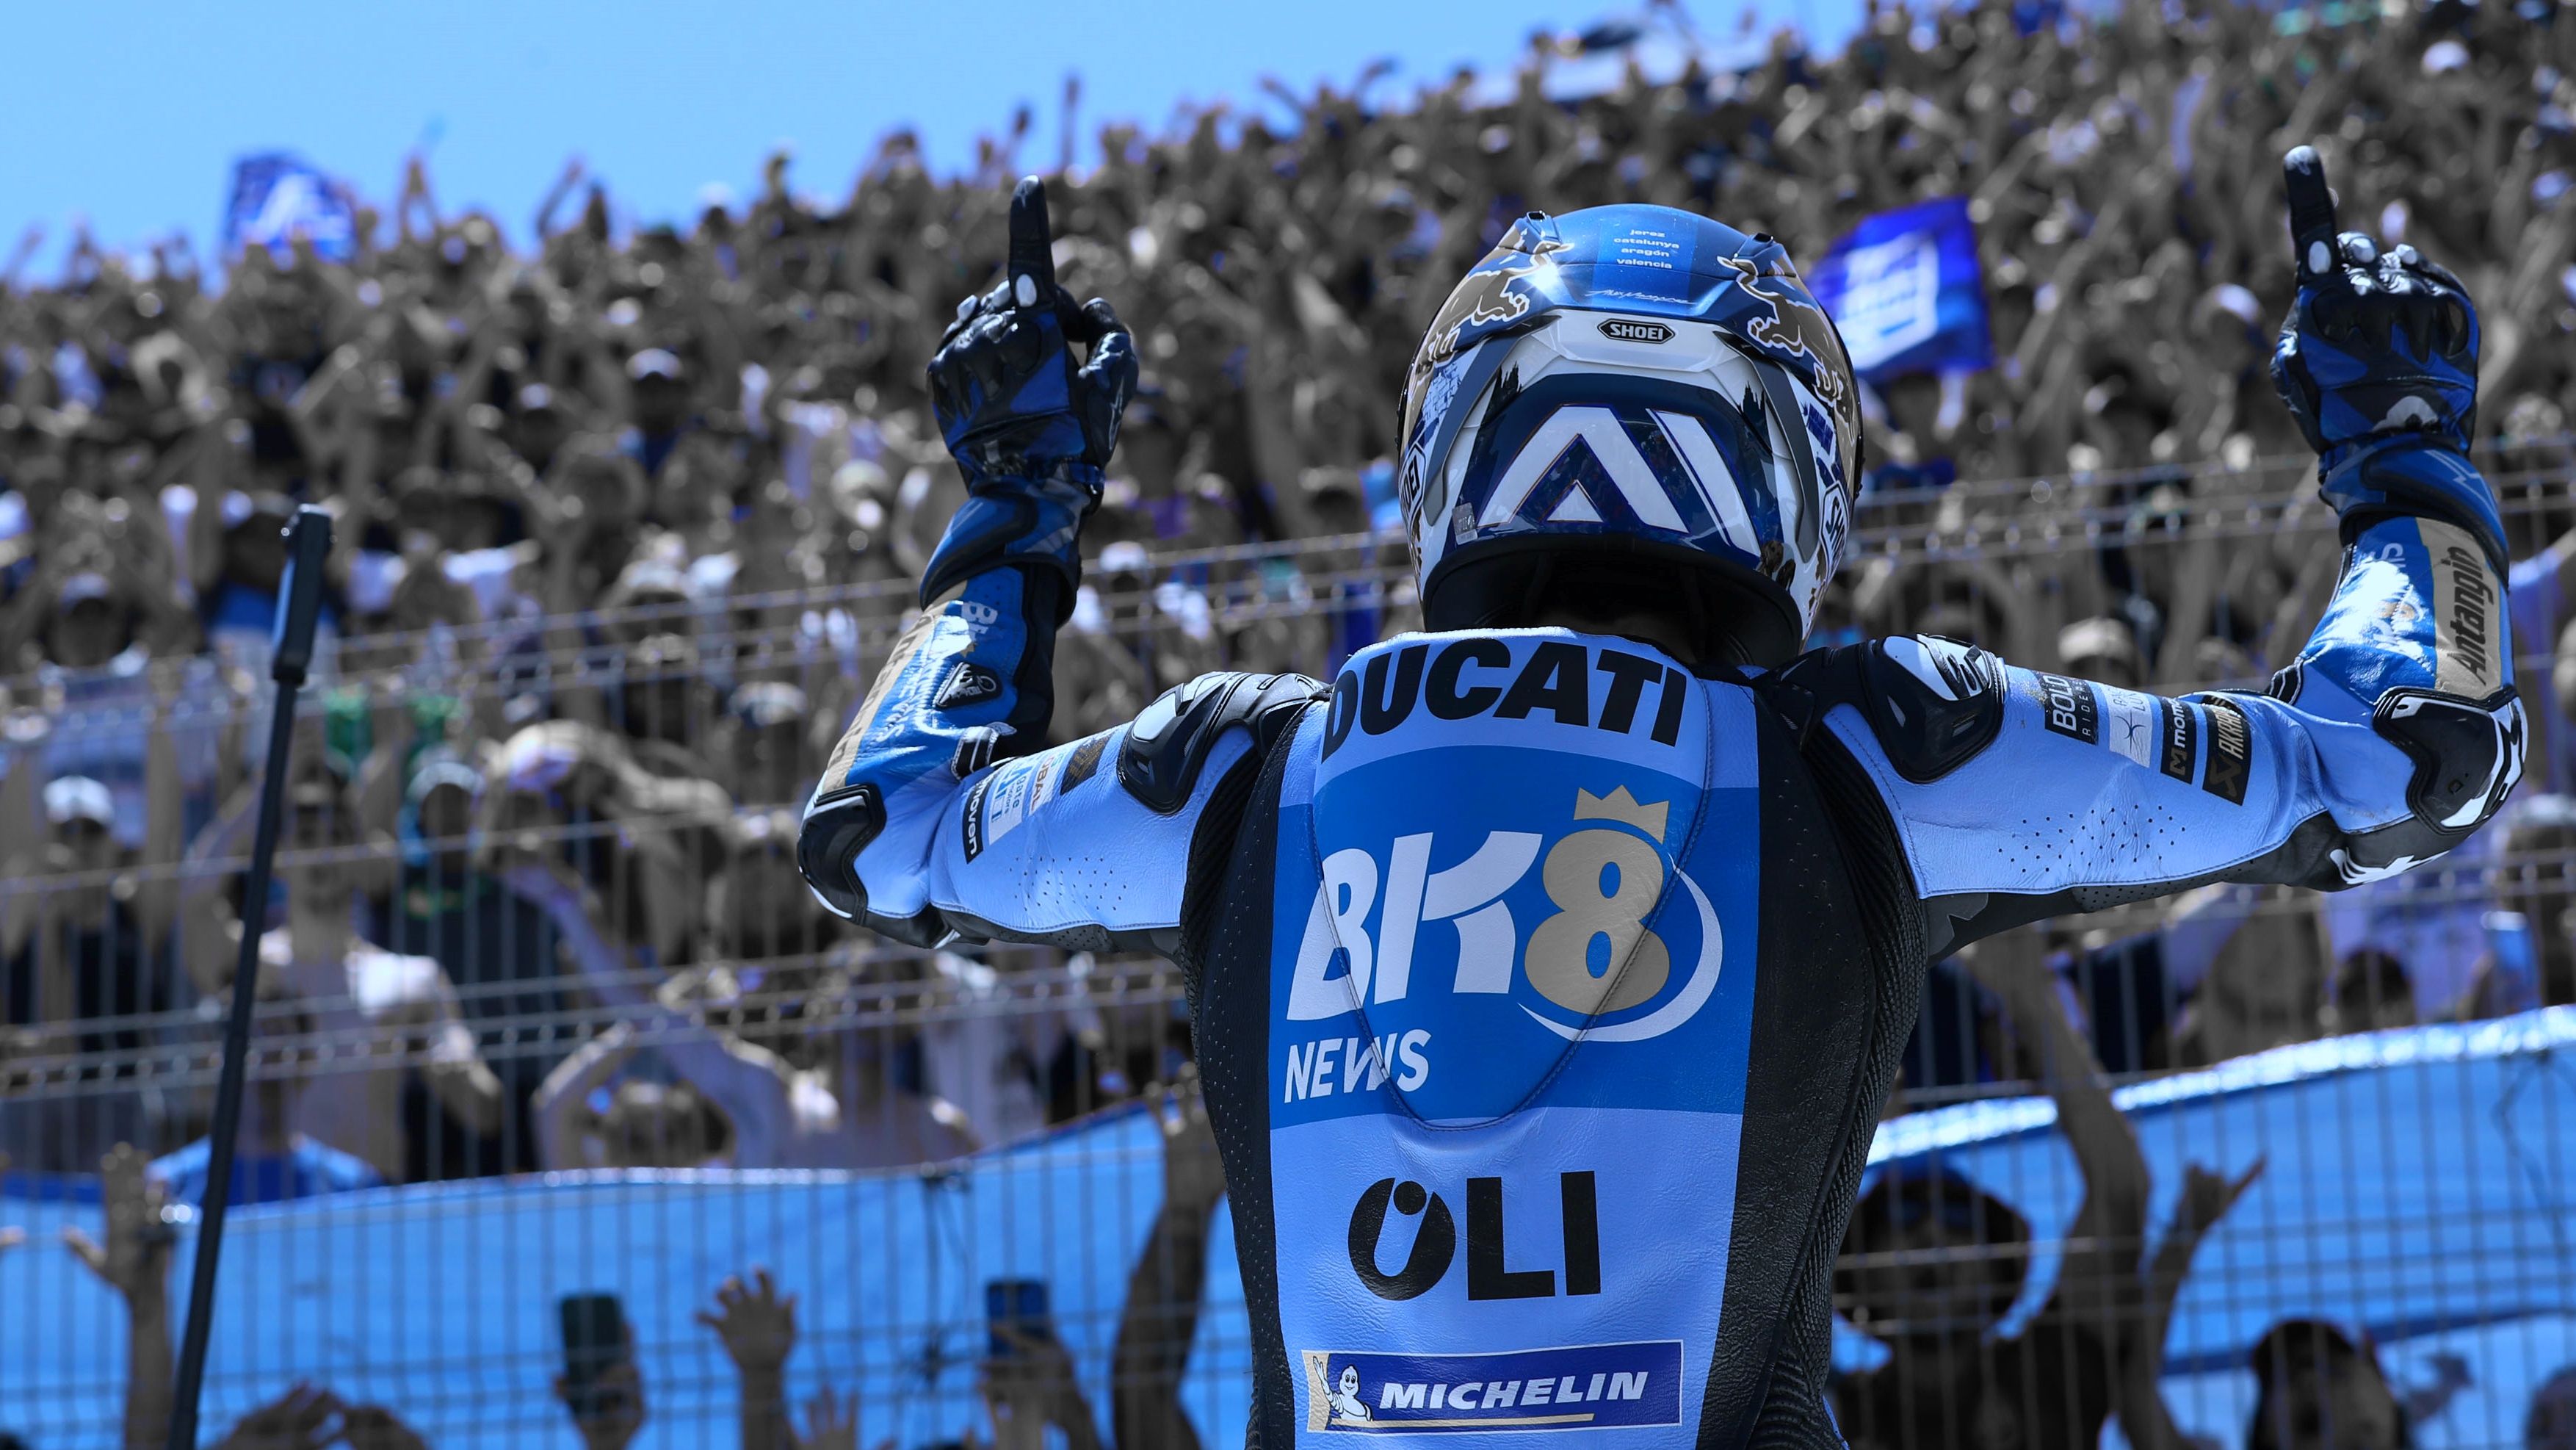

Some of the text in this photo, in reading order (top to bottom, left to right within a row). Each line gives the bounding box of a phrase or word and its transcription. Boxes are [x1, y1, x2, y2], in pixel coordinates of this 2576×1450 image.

[1613, 237, 1680, 249] catalunya
[1621, 247, 1670, 258] aragón
[1629, 228, 1666, 238] jerez
[1616, 258, 1673, 270] valencia
[1610, 323, 1664, 340] SHOEI
[2440, 546, 2494, 687] Antangin
[1322, 637, 1688, 764] DUCATI
[2043, 675, 2077, 732] BOLD
[1286, 829, 1671, 1022] BK8
[1284, 1028, 1433, 1103] NEWS
[1378, 1371, 1649, 1410] MICHELIN
